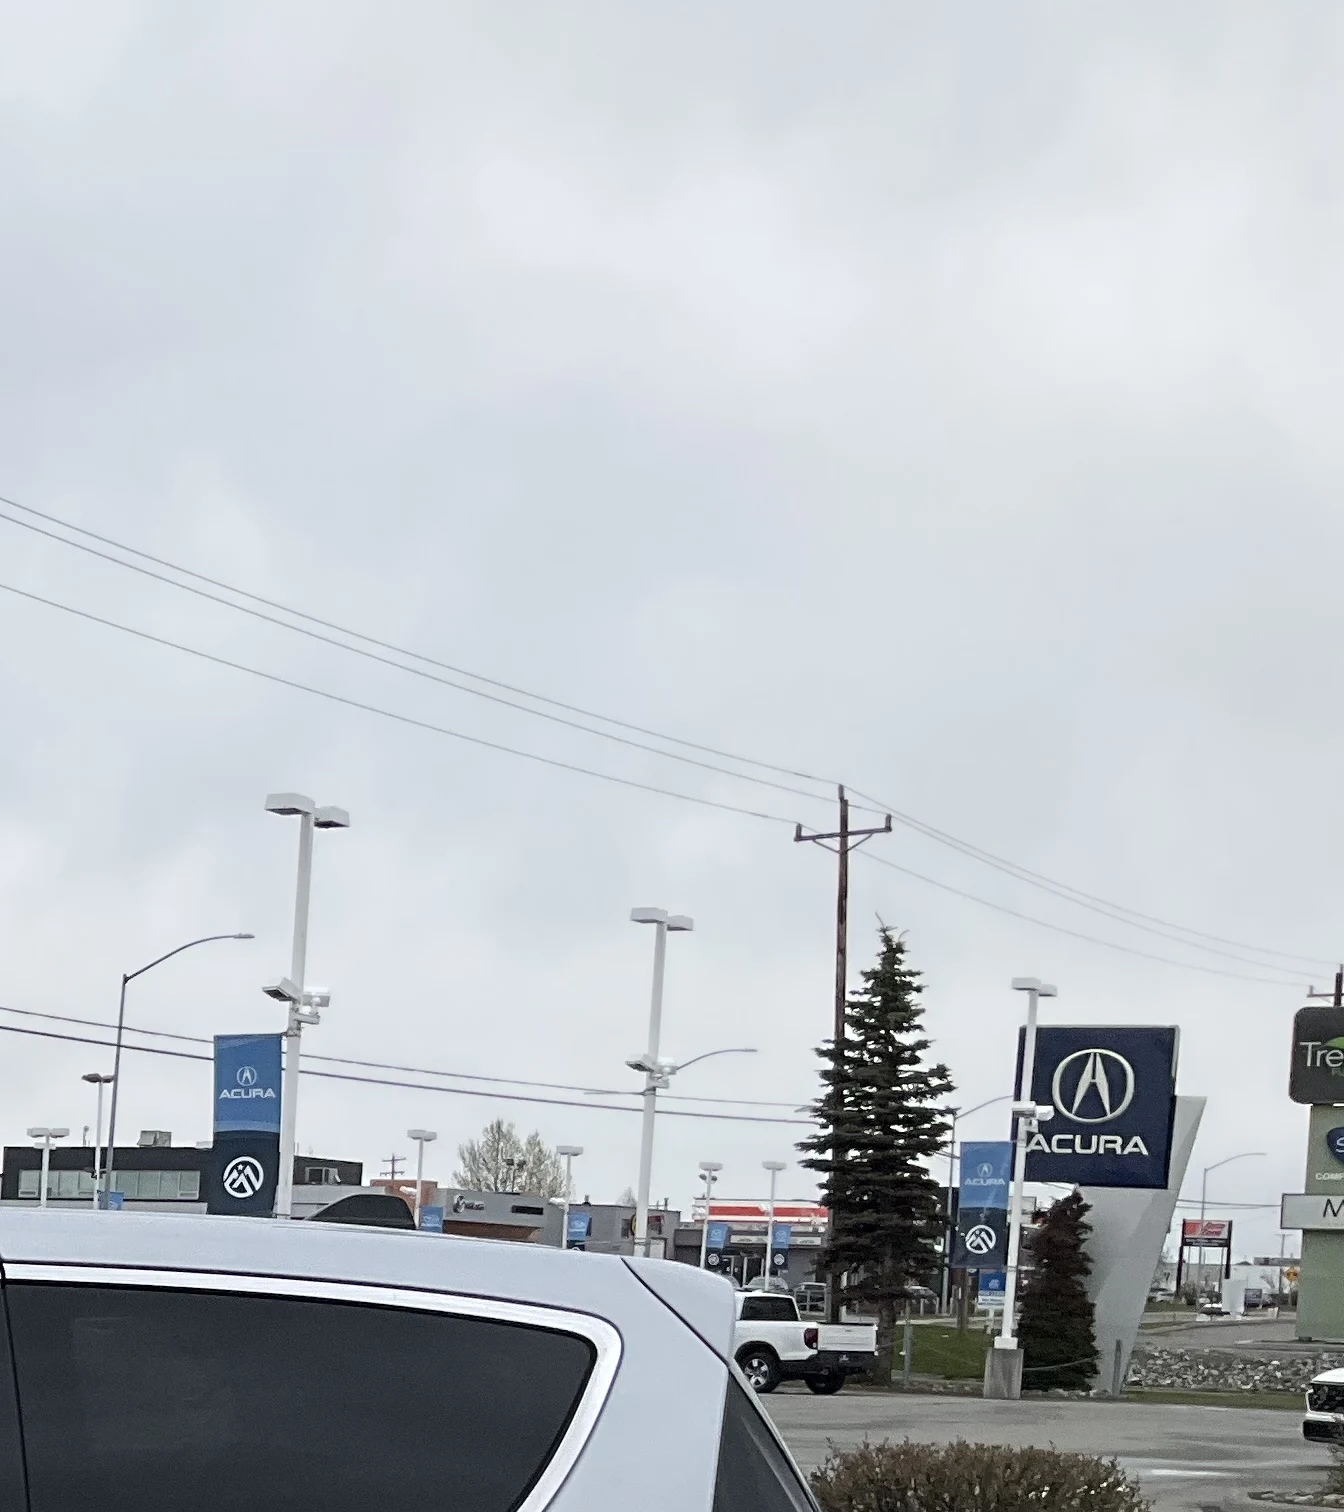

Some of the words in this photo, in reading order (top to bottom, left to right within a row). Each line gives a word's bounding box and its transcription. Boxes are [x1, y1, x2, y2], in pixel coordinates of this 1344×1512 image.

[218, 1087, 277, 1099] ACURA
[1026, 1133, 1149, 1156] ACURA
[964, 1177, 1006, 1186] ACURA
